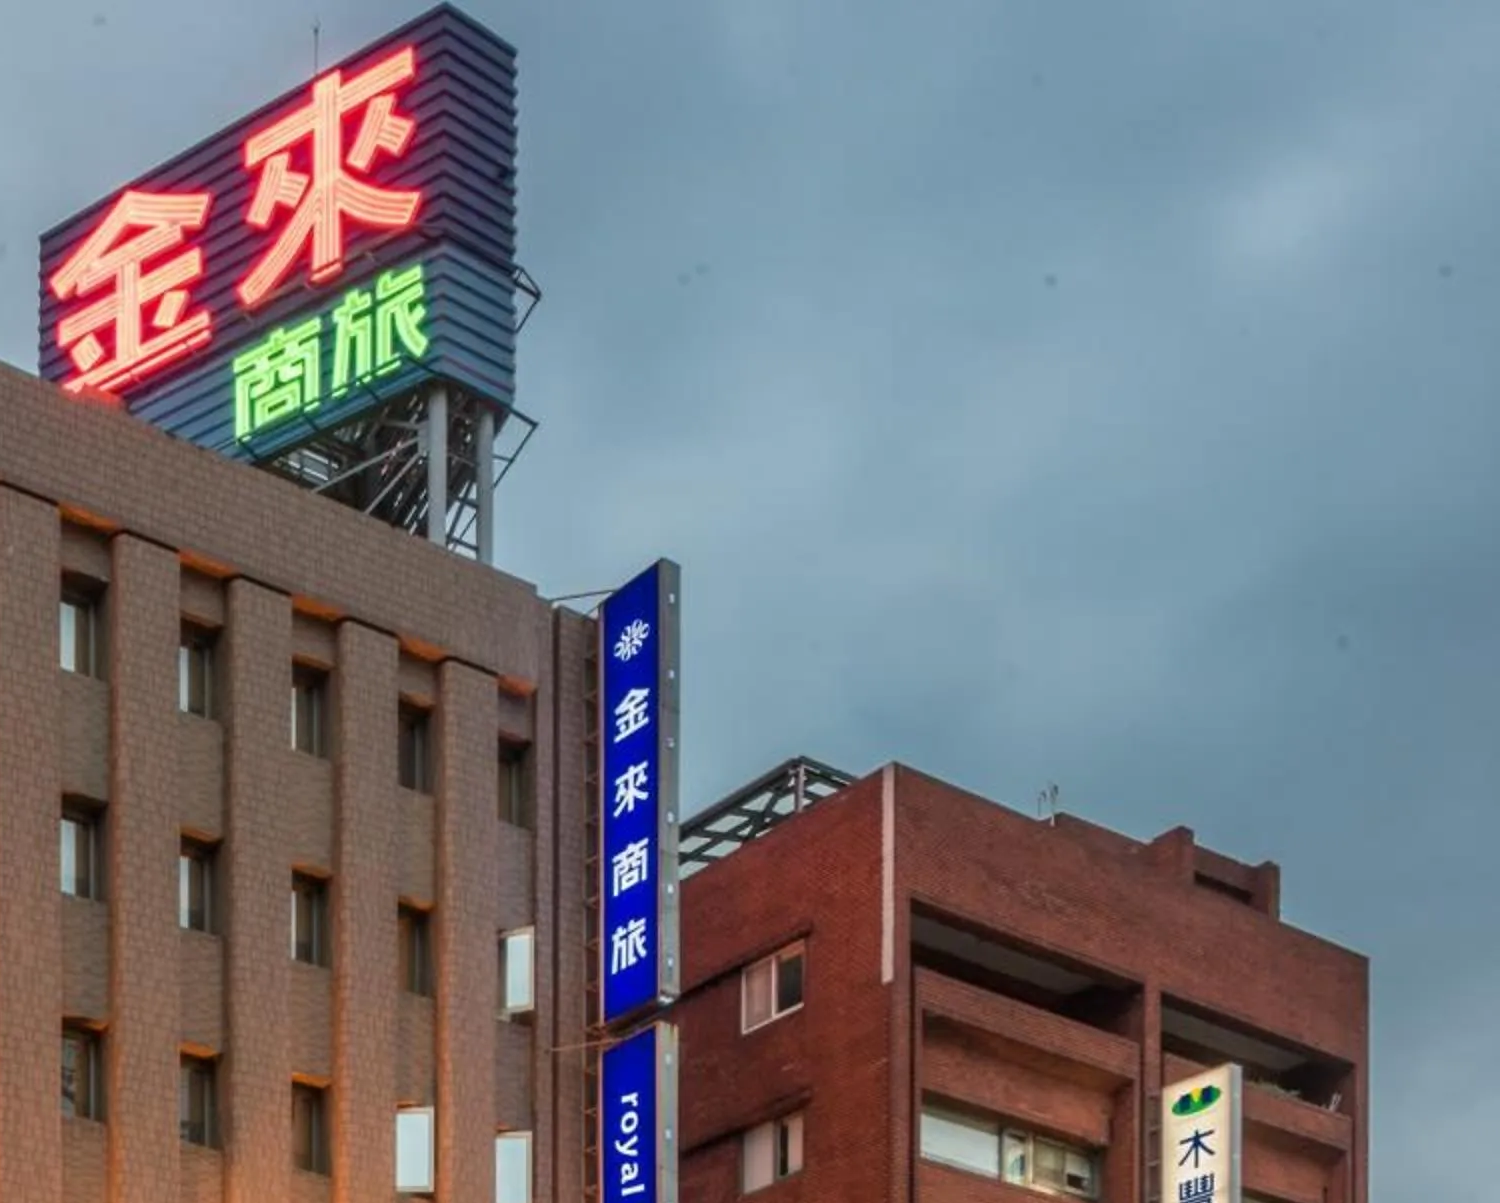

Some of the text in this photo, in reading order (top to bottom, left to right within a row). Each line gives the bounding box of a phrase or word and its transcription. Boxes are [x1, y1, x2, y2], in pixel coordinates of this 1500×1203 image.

[50, 44, 421, 396] 金來
[231, 262, 429, 446] 商旅
[610, 686, 650, 976] 金來商旅
[614, 1091, 646, 1197] royal
